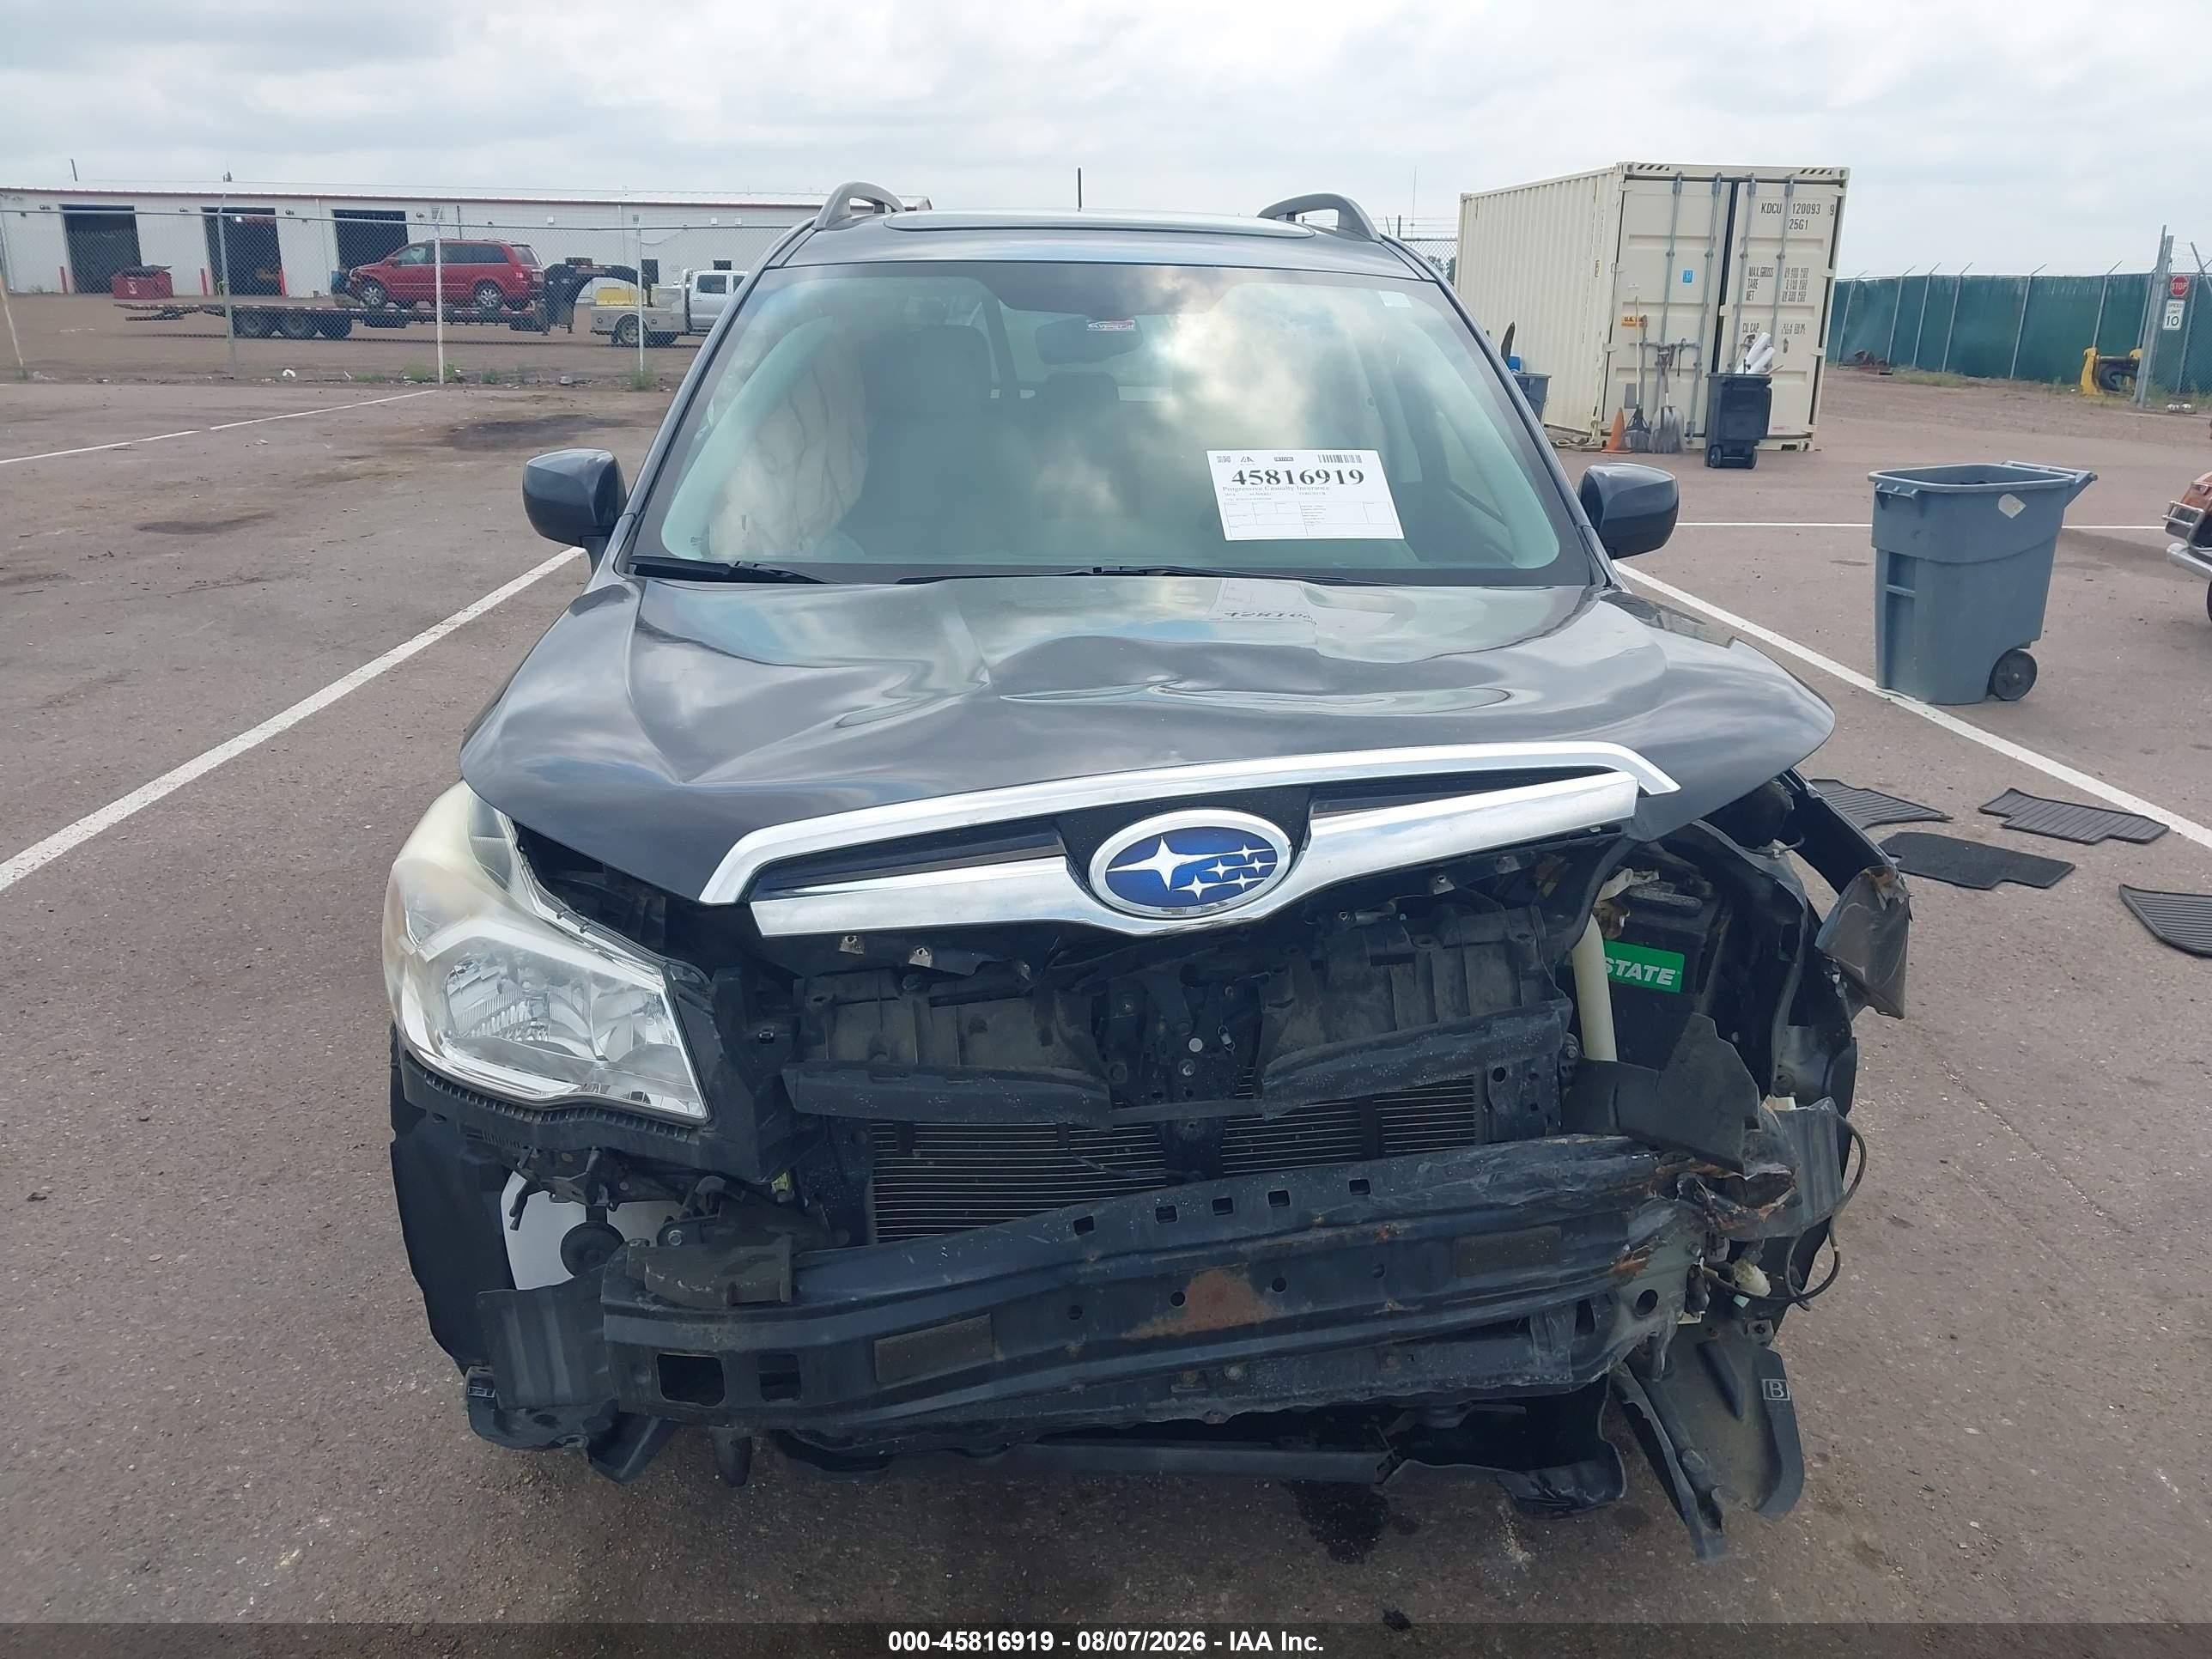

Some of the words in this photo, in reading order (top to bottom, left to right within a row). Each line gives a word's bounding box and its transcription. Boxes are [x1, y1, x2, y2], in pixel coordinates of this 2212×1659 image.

[1760, 203, 1783, 214] KDCU
[1792, 203, 1821, 214] 120093
[1829, 204, 1835, 216] 9
[1789, 218, 1808, 230] 25G1
[2171, 282, 2187, 290] STOP
[1745, 290, 1755, 301] NET
[2166, 315, 2179, 326] 10
[1231, 469, 1364, 486] 45816919
[1769, 1381, 1784, 1398] B
